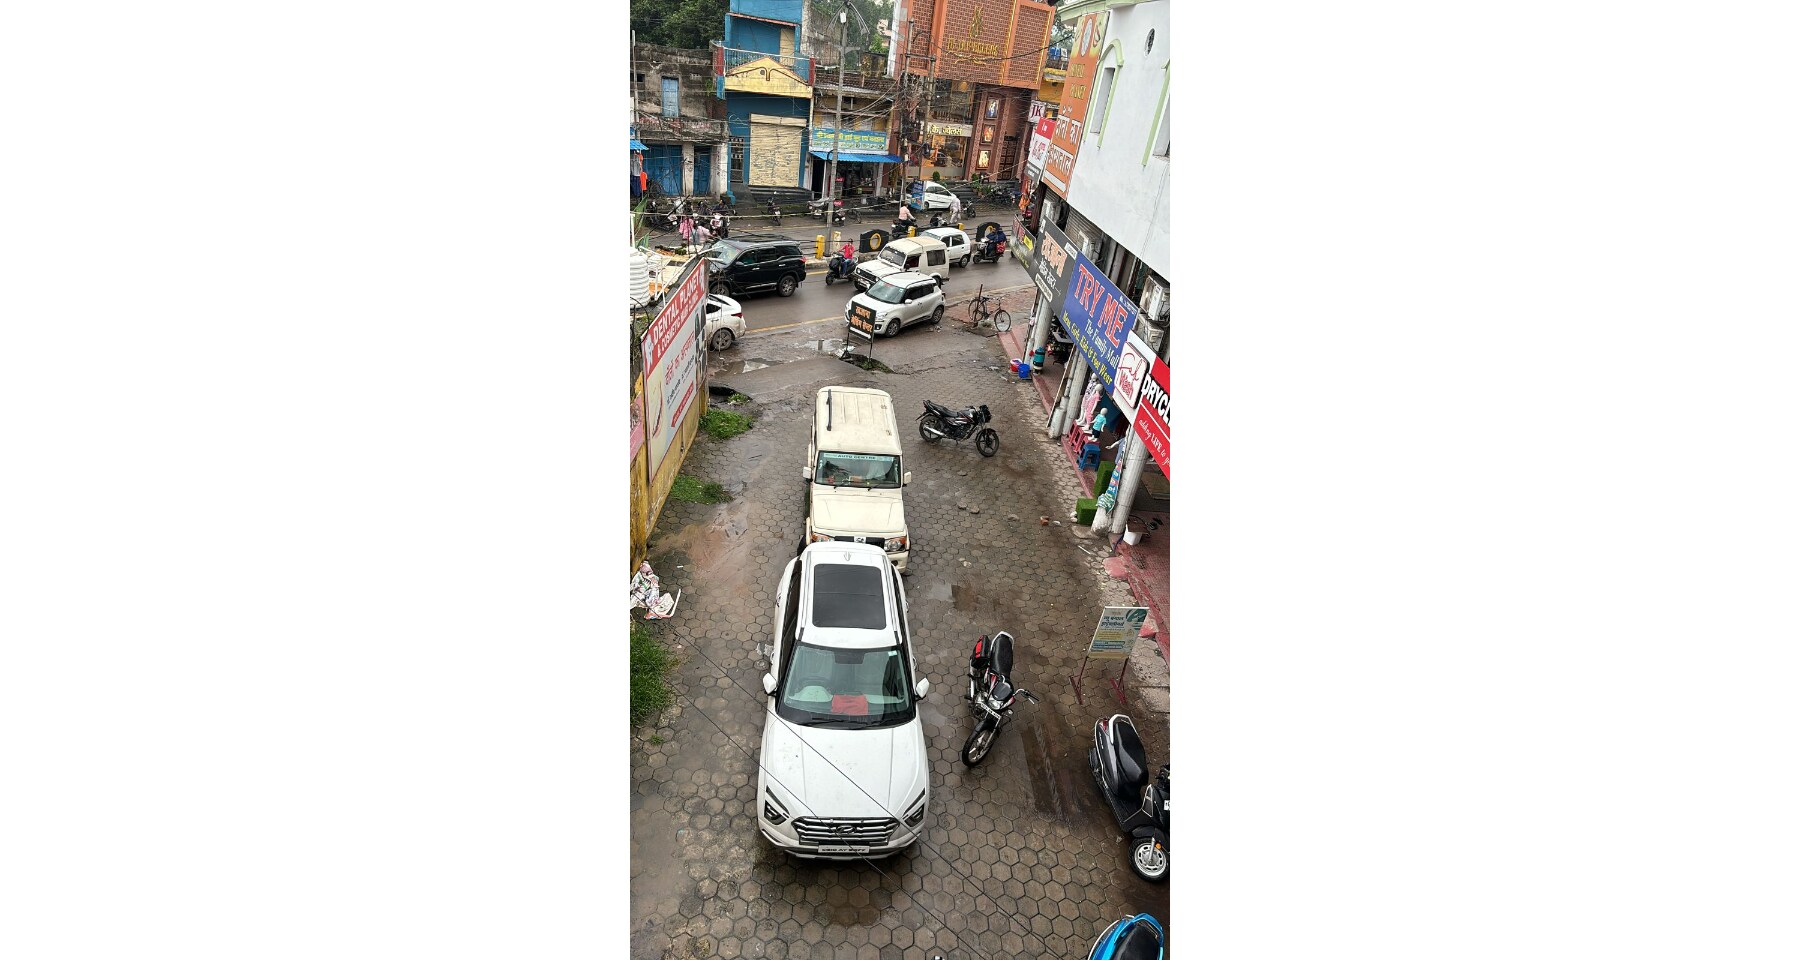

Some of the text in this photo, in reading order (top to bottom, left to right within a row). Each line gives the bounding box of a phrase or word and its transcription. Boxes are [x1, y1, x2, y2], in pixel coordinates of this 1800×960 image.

[1031, 104, 1044, 118] JK
[653, 269, 701, 345] DENTAL PLANET
[1074, 263, 1105, 318] TRY
[1097, 292, 1129, 349] ME
[661, 320, 680, 351] COSMETIC
[1084, 318, 1120, 370] The Family Mall
[1098, 365, 1113, 386] Wear
[1138, 419, 1152, 441] adding
[1150, 433, 1163, 453] LIFE
